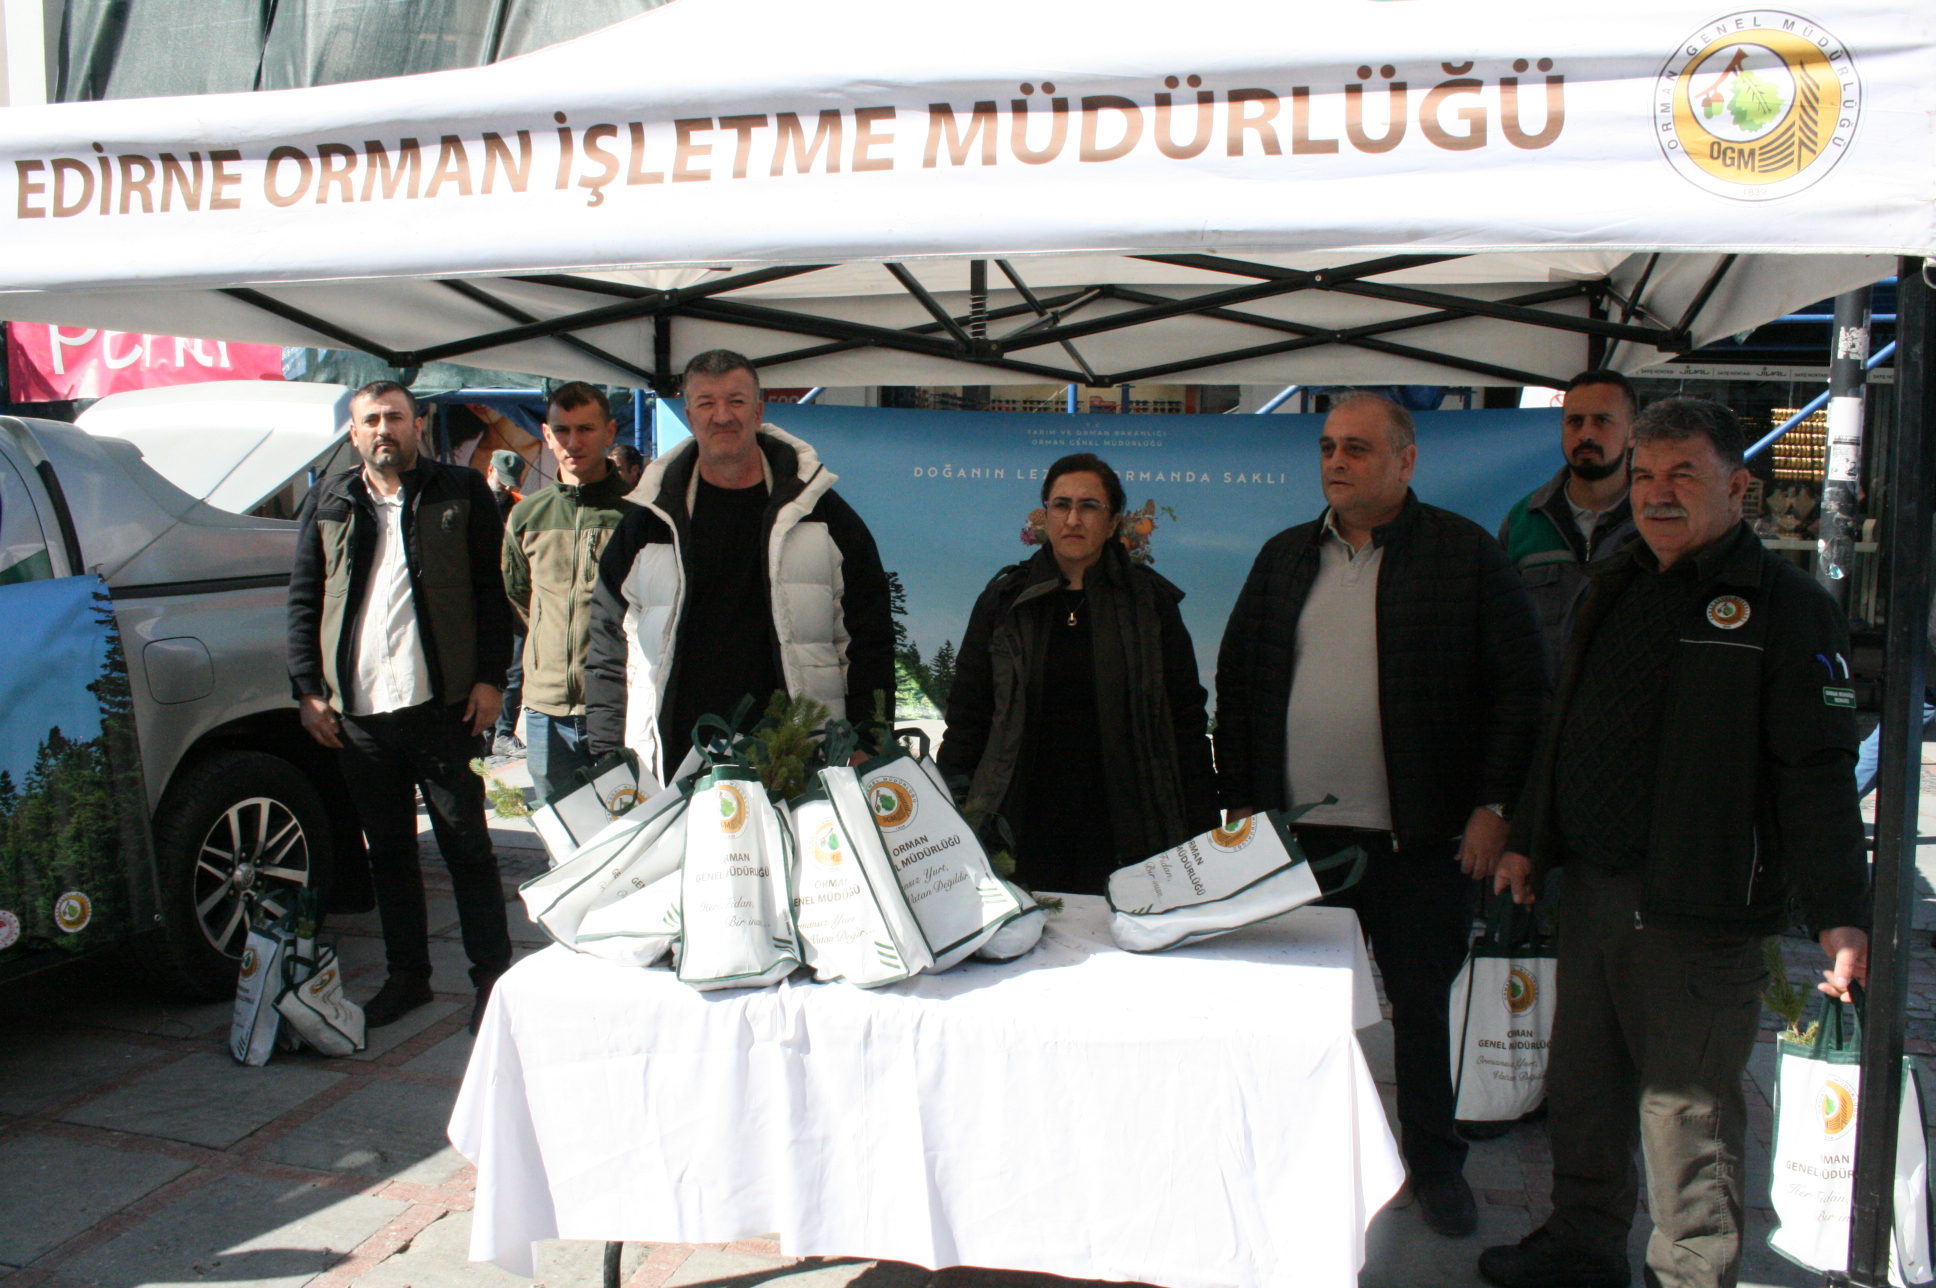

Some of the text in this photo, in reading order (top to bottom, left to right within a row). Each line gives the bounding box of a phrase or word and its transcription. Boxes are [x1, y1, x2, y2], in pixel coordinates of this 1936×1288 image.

[1686, 16, 1762, 57] GENEL
[1782, 19, 1859, 148] MÜDÜRLÜĞÜ
[14, 57, 1565, 219] EDİRNE ORMAN İŞLETME MÜDÜRLÜĞÜ
[1709, 140, 1757, 173] OGM
[913, 463, 1005, 479] DOĞANIN
[1223, 472, 1286, 484] SAKLI
[892, 834, 929, 857] ORMAN
[901, 834, 961, 868] MÜDÜRLÜĞÜ
[794, 896, 815, 907] ENEL
[1478, 1039, 1507, 1050] GENEL
[1786, 1160, 1819, 1177] GENEL
